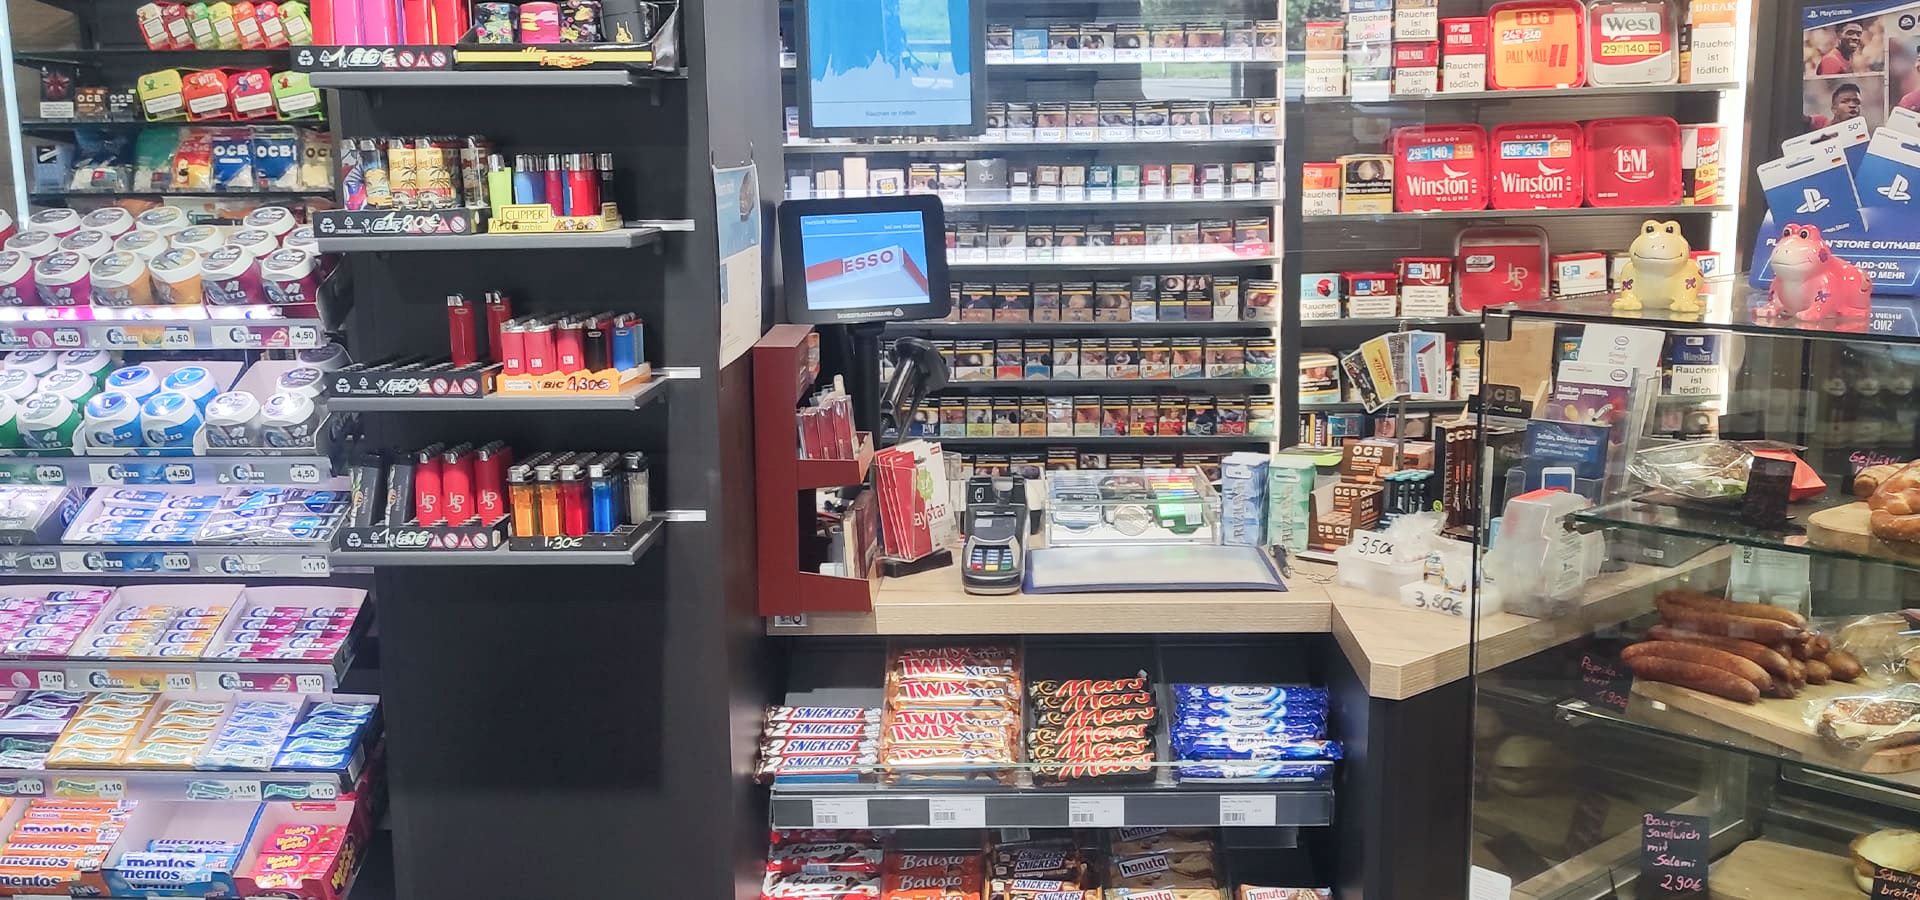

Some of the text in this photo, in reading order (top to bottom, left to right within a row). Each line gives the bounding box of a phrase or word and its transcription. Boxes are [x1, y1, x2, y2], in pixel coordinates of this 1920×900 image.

[1352, 14, 1388, 23] Rauchen
[1398, 10, 1436, 18] Rauchen
[1606, 17, 1656, 31] West
[1356, 31, 1385, 40] tödlich
[1401, 28, 1431, 36] tödlich
[1625, 44, 1645, 53] 140
[1693, 40, 1734, 49] Rauchen
[1506, 49, 1524, 64] PALL
[1707, 53, 1720, 61] ist
[1445, 62, 1484, 70] Rauchen
[1696, 65, 1729, 75] tödlich
[1398, 69, 1435, 77] Rauchen
[1459, 71, 1470, 79] ist
[1449, 80, 1479, 89] tödlich
[77, 94, 102, 103] OCB
[213, 144, 249, 156] OCB
[256, 144, 292, 157] OCB
[1430, 146, 1448, 159] 140
[1525, 142, 1544, 156] 245
[1617, 148, 1648, 174] L&M
[1407, 175, 1469, 196] Winston
[1501, 170, 1563, 193] Winston
[504, 209, 546, 221] CLIPPER
[1836, 240, 1870, 249] STORE
[843, 250, 894, 273] ESSO
[1855, 261, 1900, 271] ADD-ONS,
[1877, 271, 1906, 280] MEHR
[1675, 365, 1718, 375] Rauchen
[1690, 376, 1702, 385] ist
[1679, 386, 1711, 396] tödlich
[1352, 445, 1384, 457] OCB
[1334, 487, 1358, 497] OCB
[1361, 498, 1374, 509] OCB
[899, 655, 1000, 677] TWIX Xtra
[900, 680, 1004, 699] TWIX Xtra
[1055, 677, 1148, 698] Mars
[1061, 691, 1151, 713] Mars
[771, 707, 859, 721] 2 SNICKERS
[1064, 706, 1156, 729] Mars
[770, 722, 857, 737] 2 SNICKERS
[891, 723, 995, 742] TWIX Xtra
[1055, 723, 1148, 745] Mars
[766, 739, 853, 755] 2 SNICKERS
[1055, 739, 1152, 759] Mars
[762, 755, 852, 773] 2 SNICKERS
[792, 843, 843, 855] bueno
[1647, 841, 1669, 852] mit
[1, 856, 70, 867] mentos
[126, 858, 196, 868] mentos
[902, 855, 965, 871] Balisto
[1016, 858, 1062, 870] SNICKERS
[1122, 856, 1166, 875] hanuta
[1652, 854, 1697, 868] Salami
[123, 868, 180, 880] mentos
[792, 874, 843, 887] bueno
[900, 876, 963, 892] Balisto
[1015, 879, 1061, 890] SNICKERS
[1035, 891, 1082, 900] SNICKERS
[1247, 889, 1287, 900] hanuta
